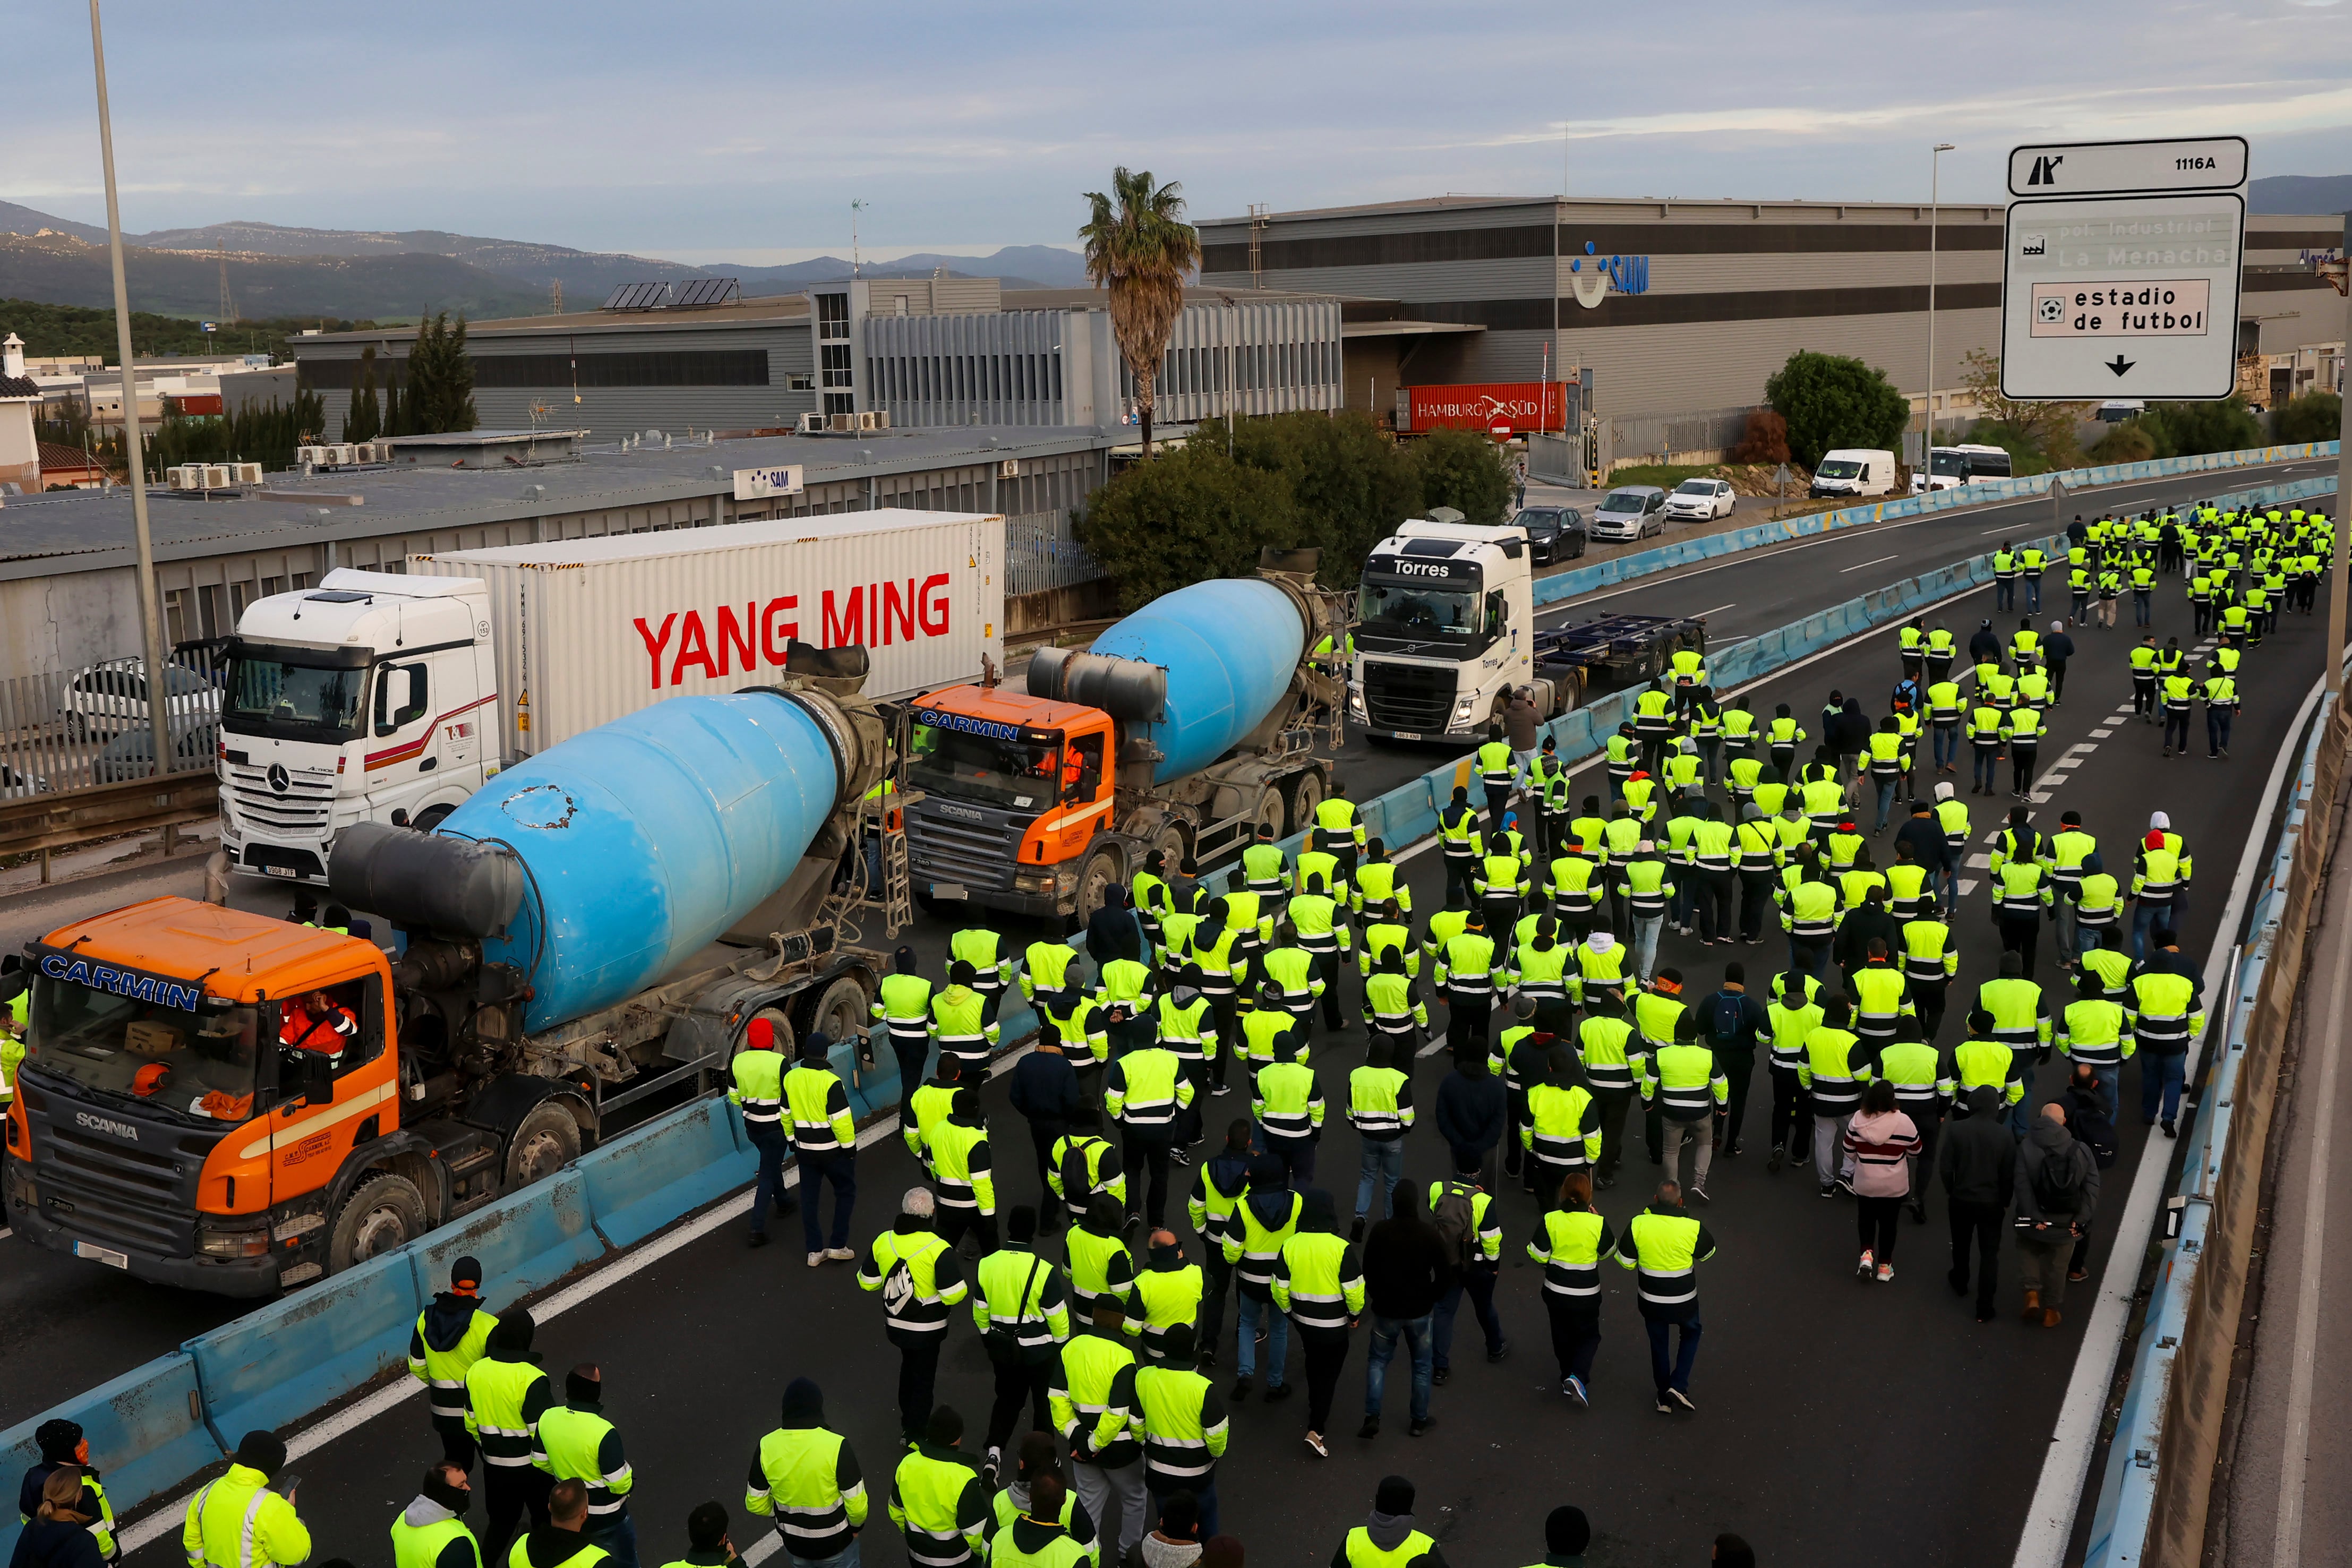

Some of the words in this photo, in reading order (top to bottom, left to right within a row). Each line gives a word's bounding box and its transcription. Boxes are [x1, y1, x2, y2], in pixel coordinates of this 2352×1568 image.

[2175, 157, 2216, 170] 1116A
[2059, 224, 2094, 241] pol.
[2109, 219, 2212, 236] Industrial
[2058, 250, 2090, 267] La
[2108, 246, 2226, 265] Menacha
[2075, 287, 2176, 306] estadio
[2074, 313, 2102, 330] de
[2122, 311, 2202, 330] futbol
[1418, 403, 1483, 417] HAMBURG
[1509, 400, 1537, 418] SÜD
[1394, 559, 1449, 578] Torres
[633, 595, 798, 689] YANG
[822, 572, 950, 649] MING
[1483, 658, 1498, 669] Torres
[920, 710, 1020, 742] CARMIN
[939, 804, 982, 821] SCANIA
[268, 866, 282, 875] 3908
[41, 954, 200, 1013] CARMIN
[75, 1111, 139, 1141] SCANIA
